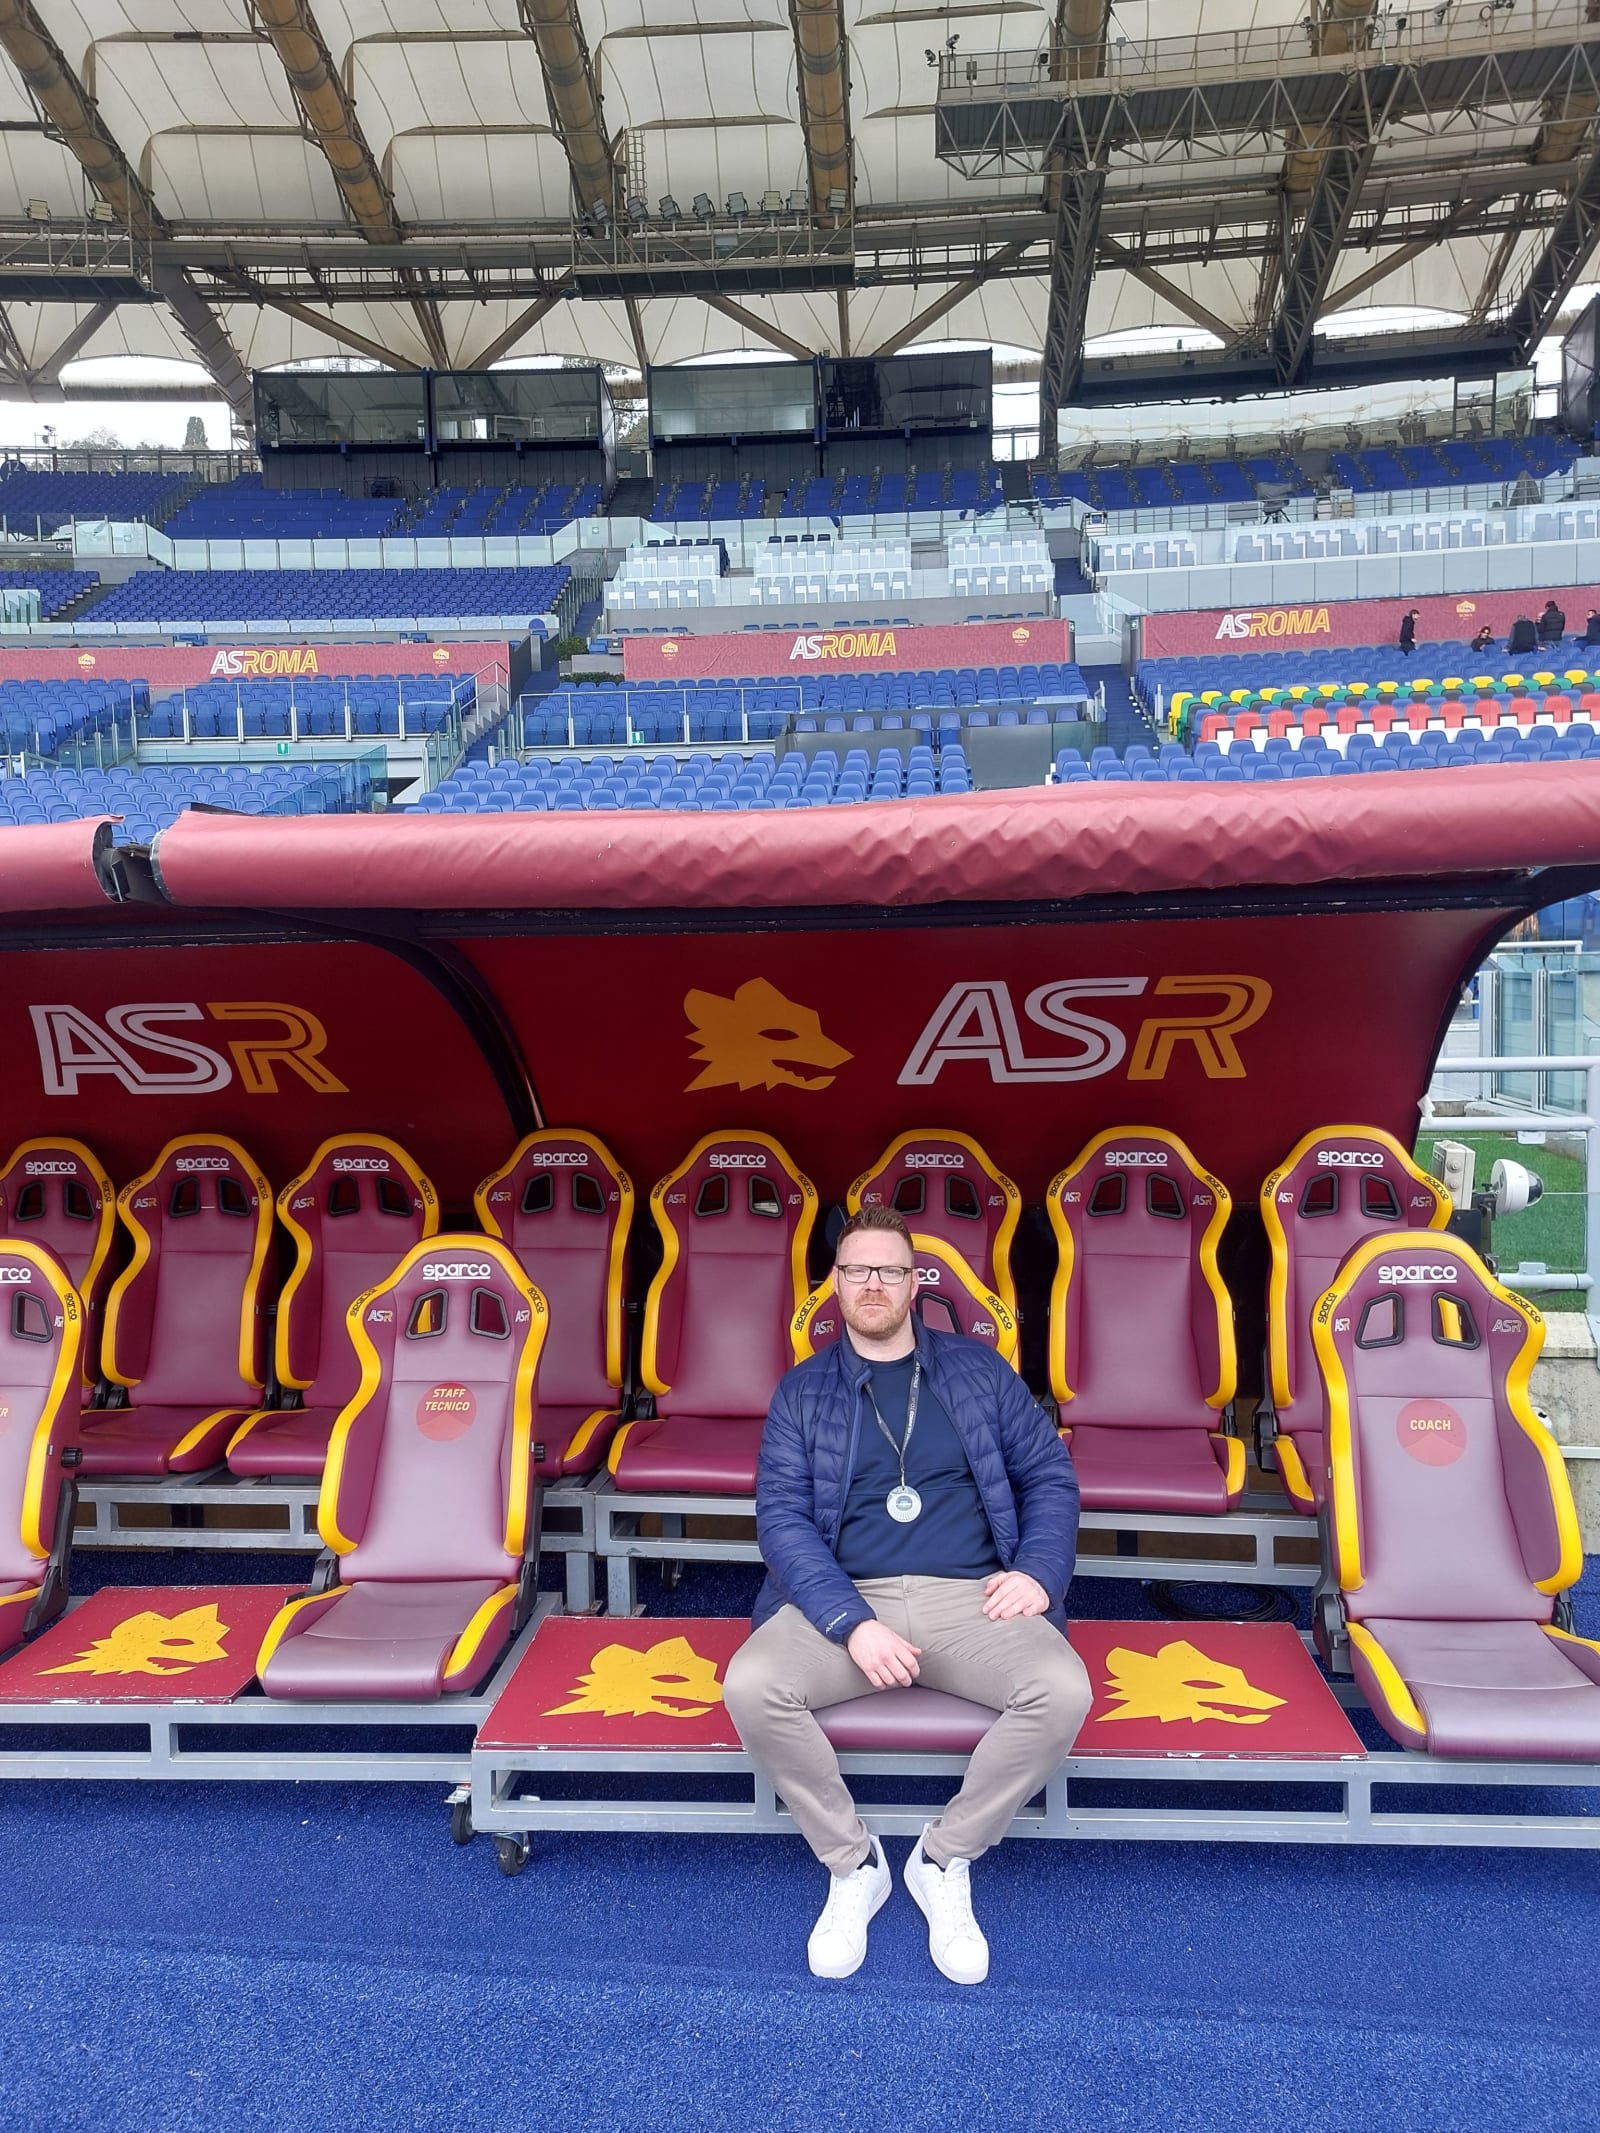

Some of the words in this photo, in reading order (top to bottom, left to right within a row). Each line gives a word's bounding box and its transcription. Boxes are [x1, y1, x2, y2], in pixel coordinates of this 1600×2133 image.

[896, 974, 1272, 1085] ASR
[29, 1002, 350, 1095] ASR
[176, 1158, 229, 1171] sparco
[333, 1158, 390, 1171] sparco
[533, 1152, 588, 1166] sparco
[710, 1154, 766, 1168] sparco
[905, 1153, 964, 1168] sparco
[1105, 1152, 1168, 1167] sparco
[1318, 1151, 1383, 1166] sparco
[25, 1161, 77, 1175] sparco
[1064, 1192, 1081, 1202] ASR
[1278, 1192, 1293, 1203] ASR
[0, 1267, 31, 1283] rco
[423, 1263, 491, 1281] sparco
[1378, 1265, 1457, 1285] sparco
[794, 1295, 819, 1332] sparco
[985, 1295, 1013, 1331] sparco
[1318, 1292, 1338, 1325] sparco
[1506, 1292, 1541, 1324] sparco
[368, 1310, 392, 1322] ASR
[814, 1319, 834, 1336] ASR
[972, 1321, 995, 1336] ASR
[1335, 1317, 1350, 1332] ASR
[1492, 1319, 1522, 1333] ASR
[433, 1388, 466, 1398] STAFF
[425, 1401, 470, 1411] TECNICO
[1410, 1419, 1451, 1431] COACH
